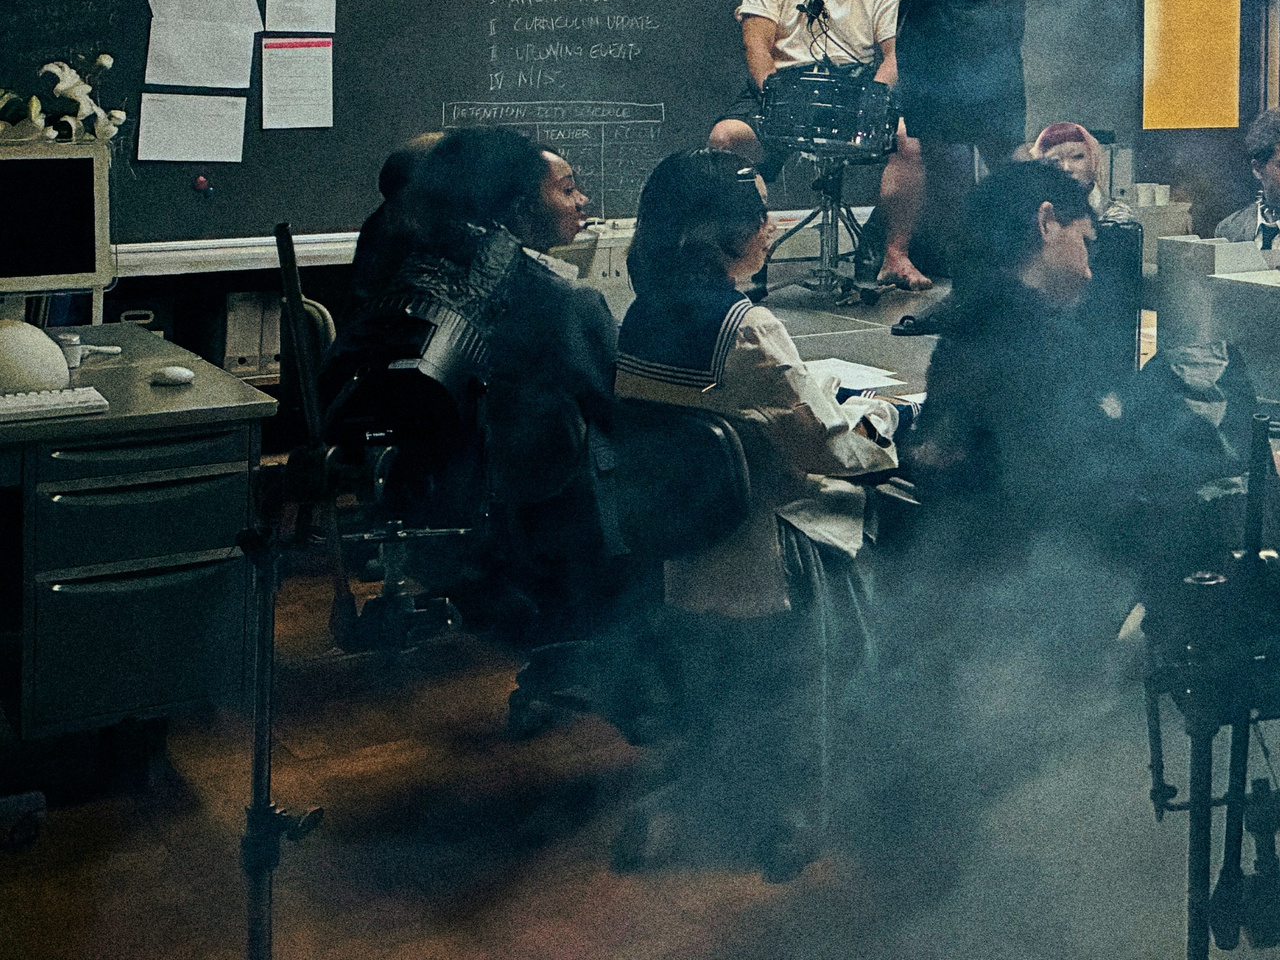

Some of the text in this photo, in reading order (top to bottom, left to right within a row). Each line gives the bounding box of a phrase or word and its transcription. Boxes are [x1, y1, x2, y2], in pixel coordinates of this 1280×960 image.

[513, 16, 599, 32] CURRICULUM
[606, 15, 660, 31] UPDATE
[453, 104, 526, 120] DETENTION
[543, 128, 591, 139] TEACHER
